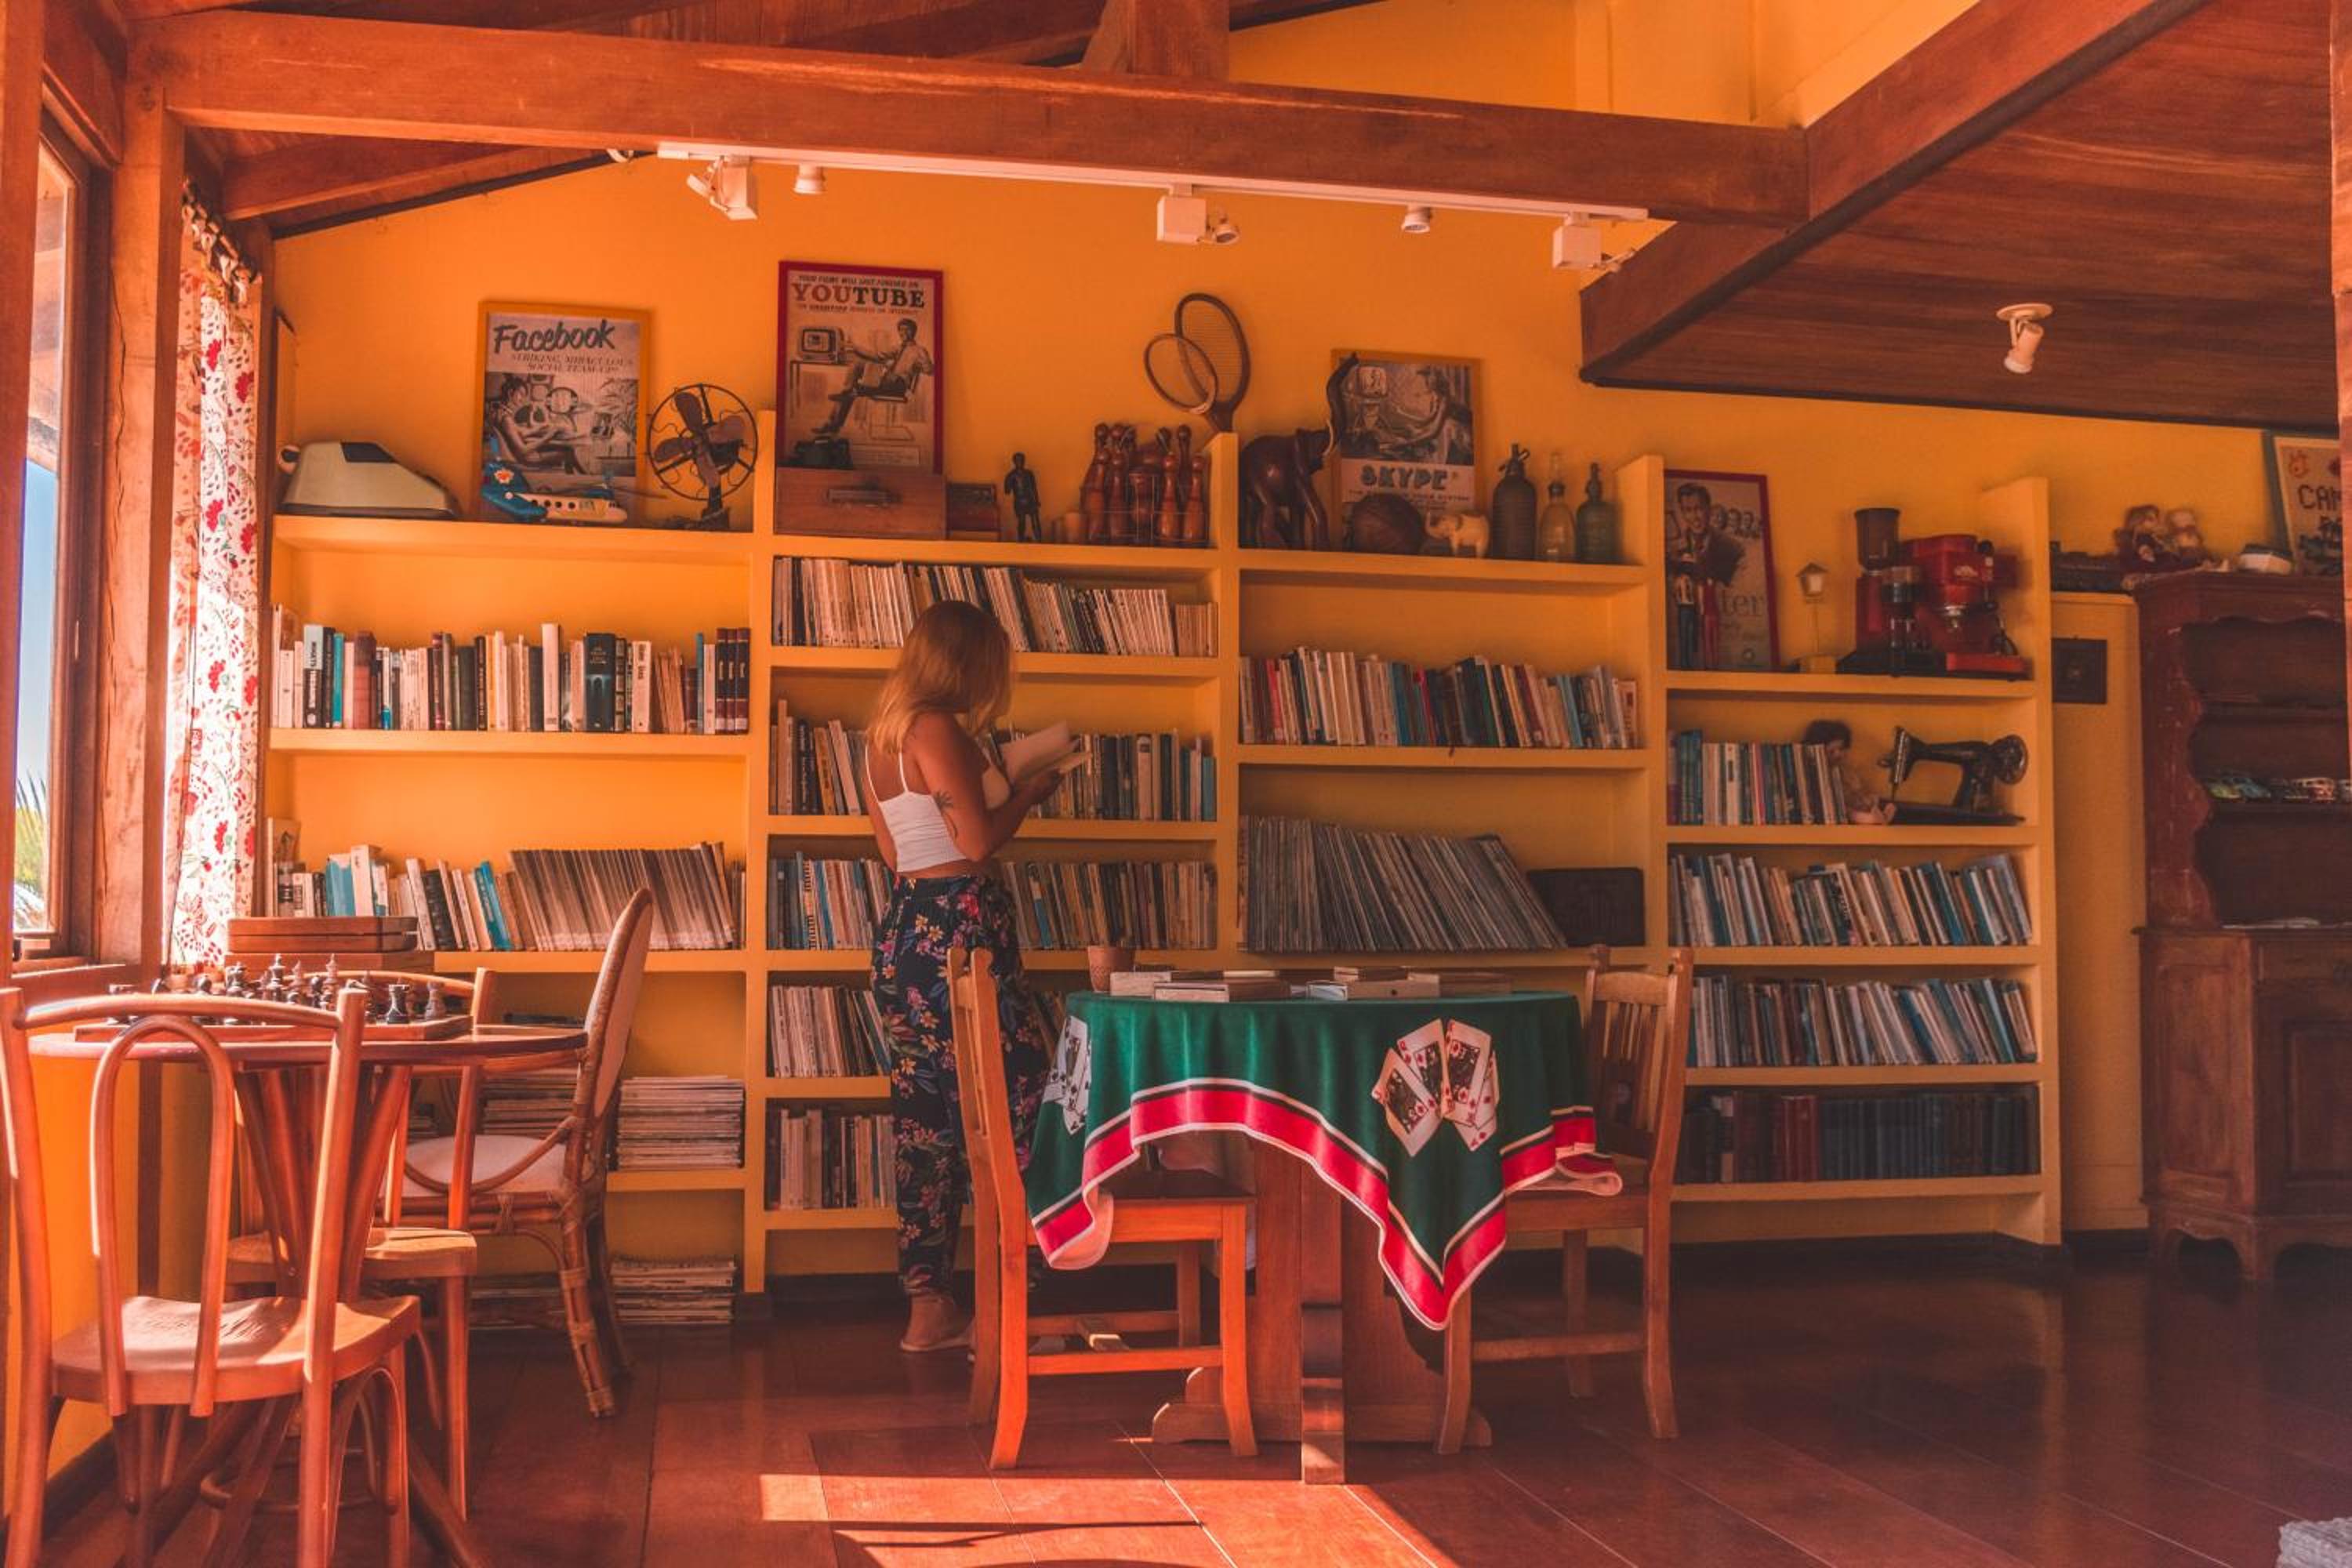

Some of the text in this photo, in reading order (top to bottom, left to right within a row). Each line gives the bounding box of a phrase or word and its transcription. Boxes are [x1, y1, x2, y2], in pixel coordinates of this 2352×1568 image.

[791, 282, 924, 308] YOUTUBE
[493, 319, 615, 354] Facebook
[1361, 465, 1447, 490] SKYPE
